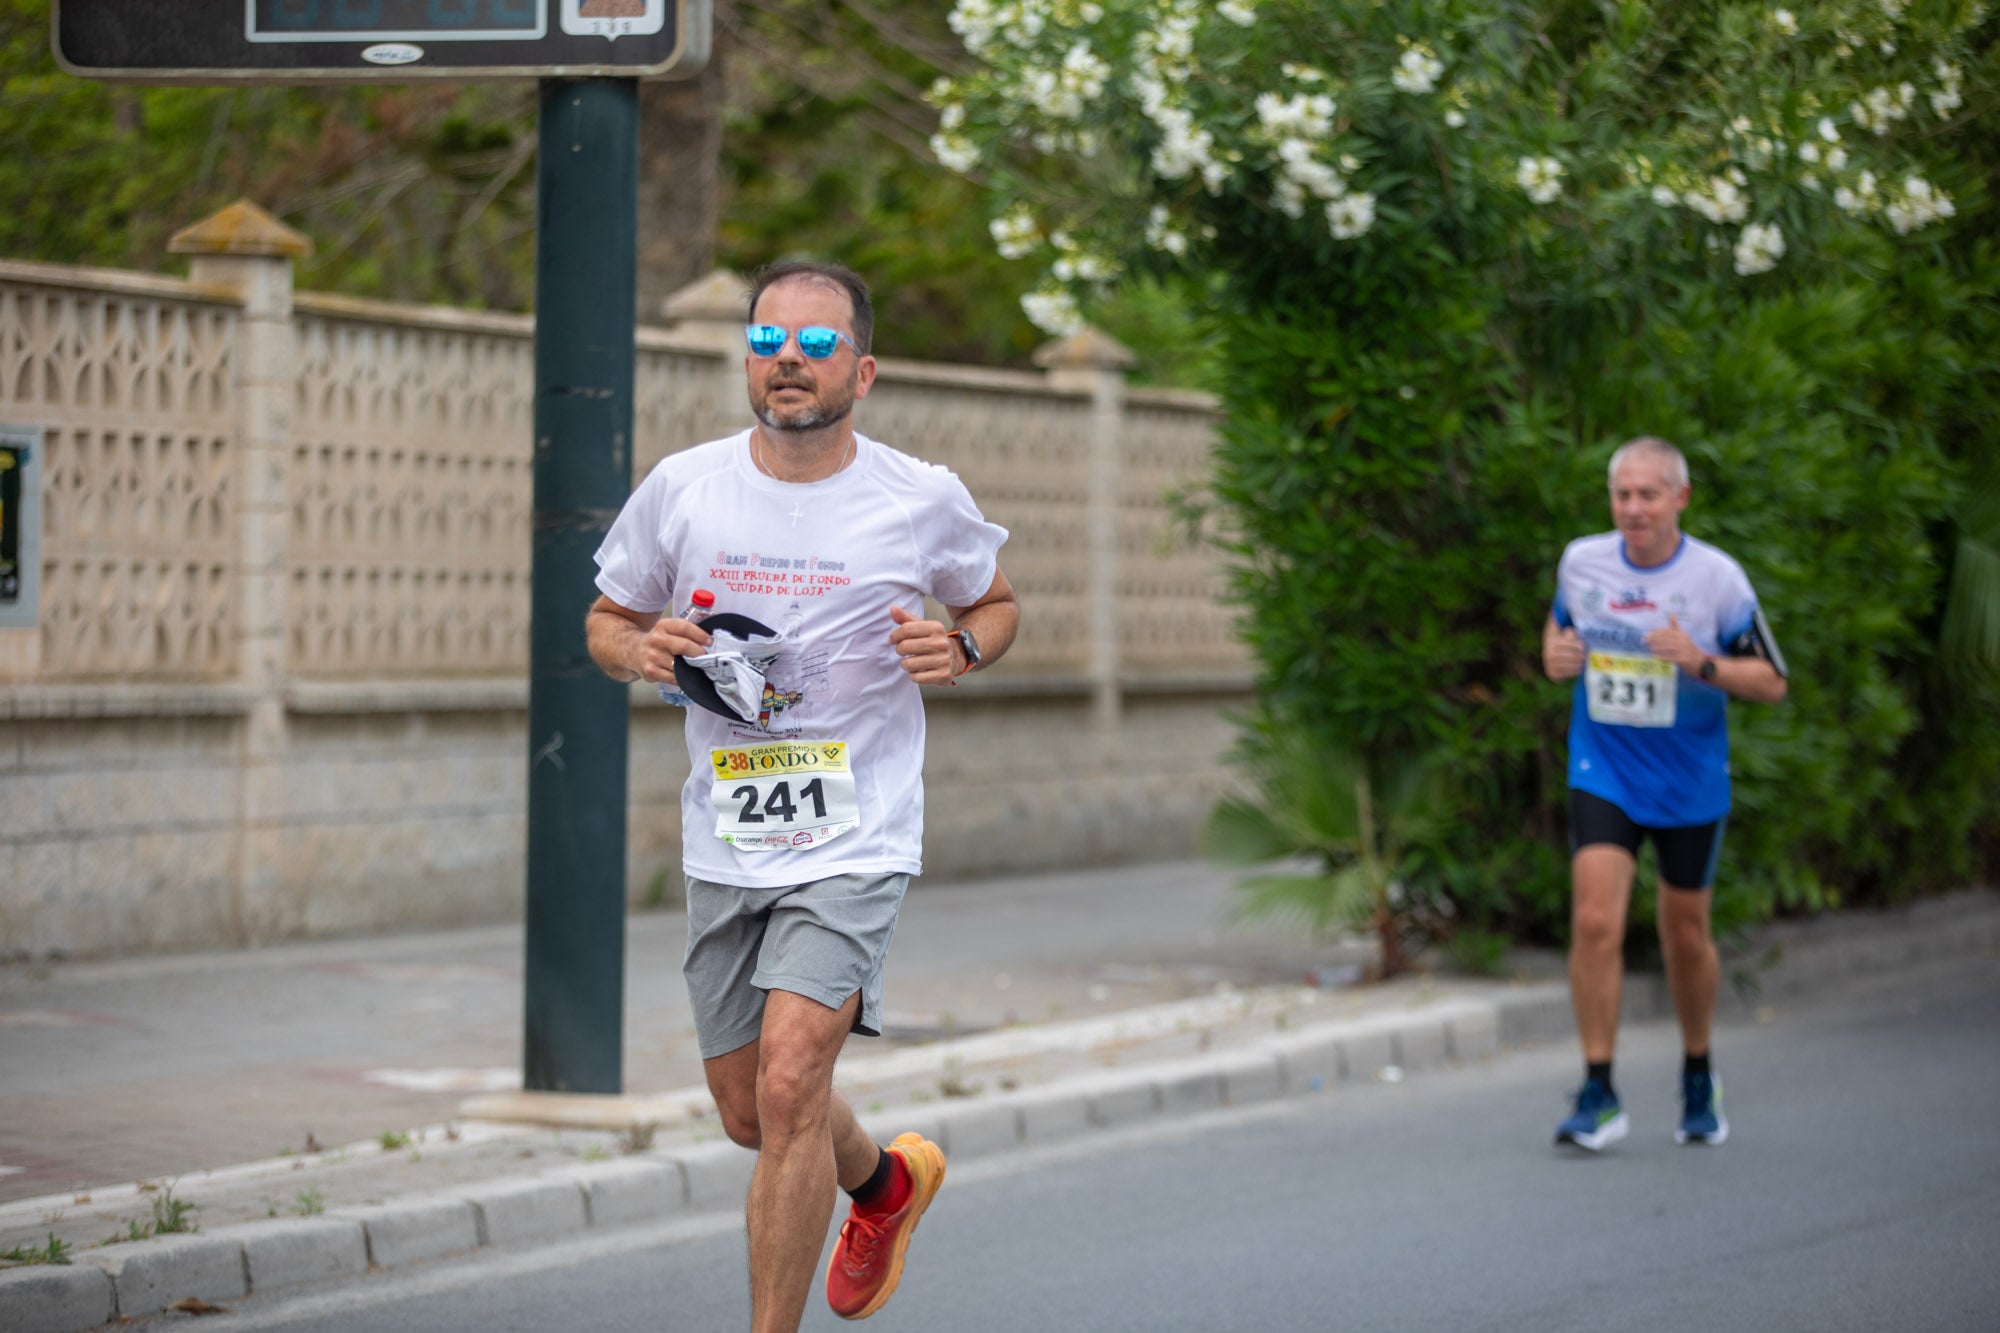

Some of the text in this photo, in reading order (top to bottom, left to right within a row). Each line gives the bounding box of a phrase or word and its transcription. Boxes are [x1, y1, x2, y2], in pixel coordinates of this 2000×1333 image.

[793, 559, 807, 570] DE
[709, 568, 851, 586] XXIII PRUEBA DE FONDO
[776, 586, 791, 595] DE
[1600, 675, 1655, 709] 231
[751, 747, 776, 757] GRAN
[728, 752, 818, 771] 38 FONDO
[731, 778, 827, 823] 241
